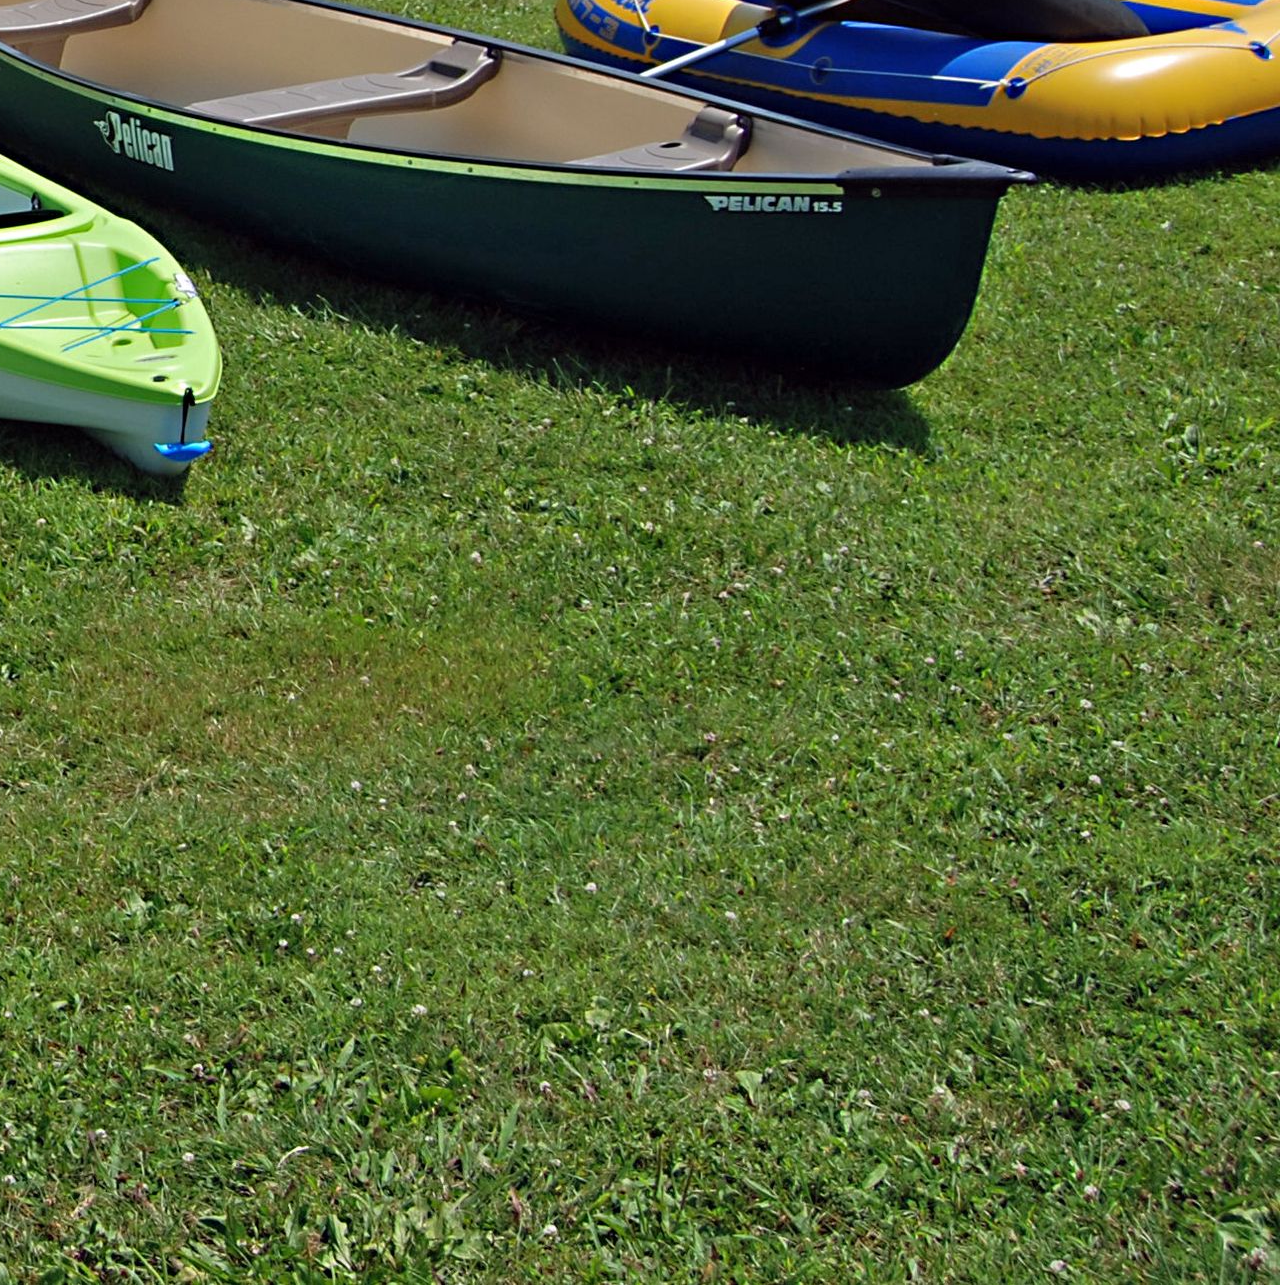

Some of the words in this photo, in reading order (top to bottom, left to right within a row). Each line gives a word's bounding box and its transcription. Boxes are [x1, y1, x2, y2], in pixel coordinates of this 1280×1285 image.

[102, 111, 175, 172] Pelican
[704, 196, 810, 212] PELICAN
[812, 202, 842, 212] 15.5
